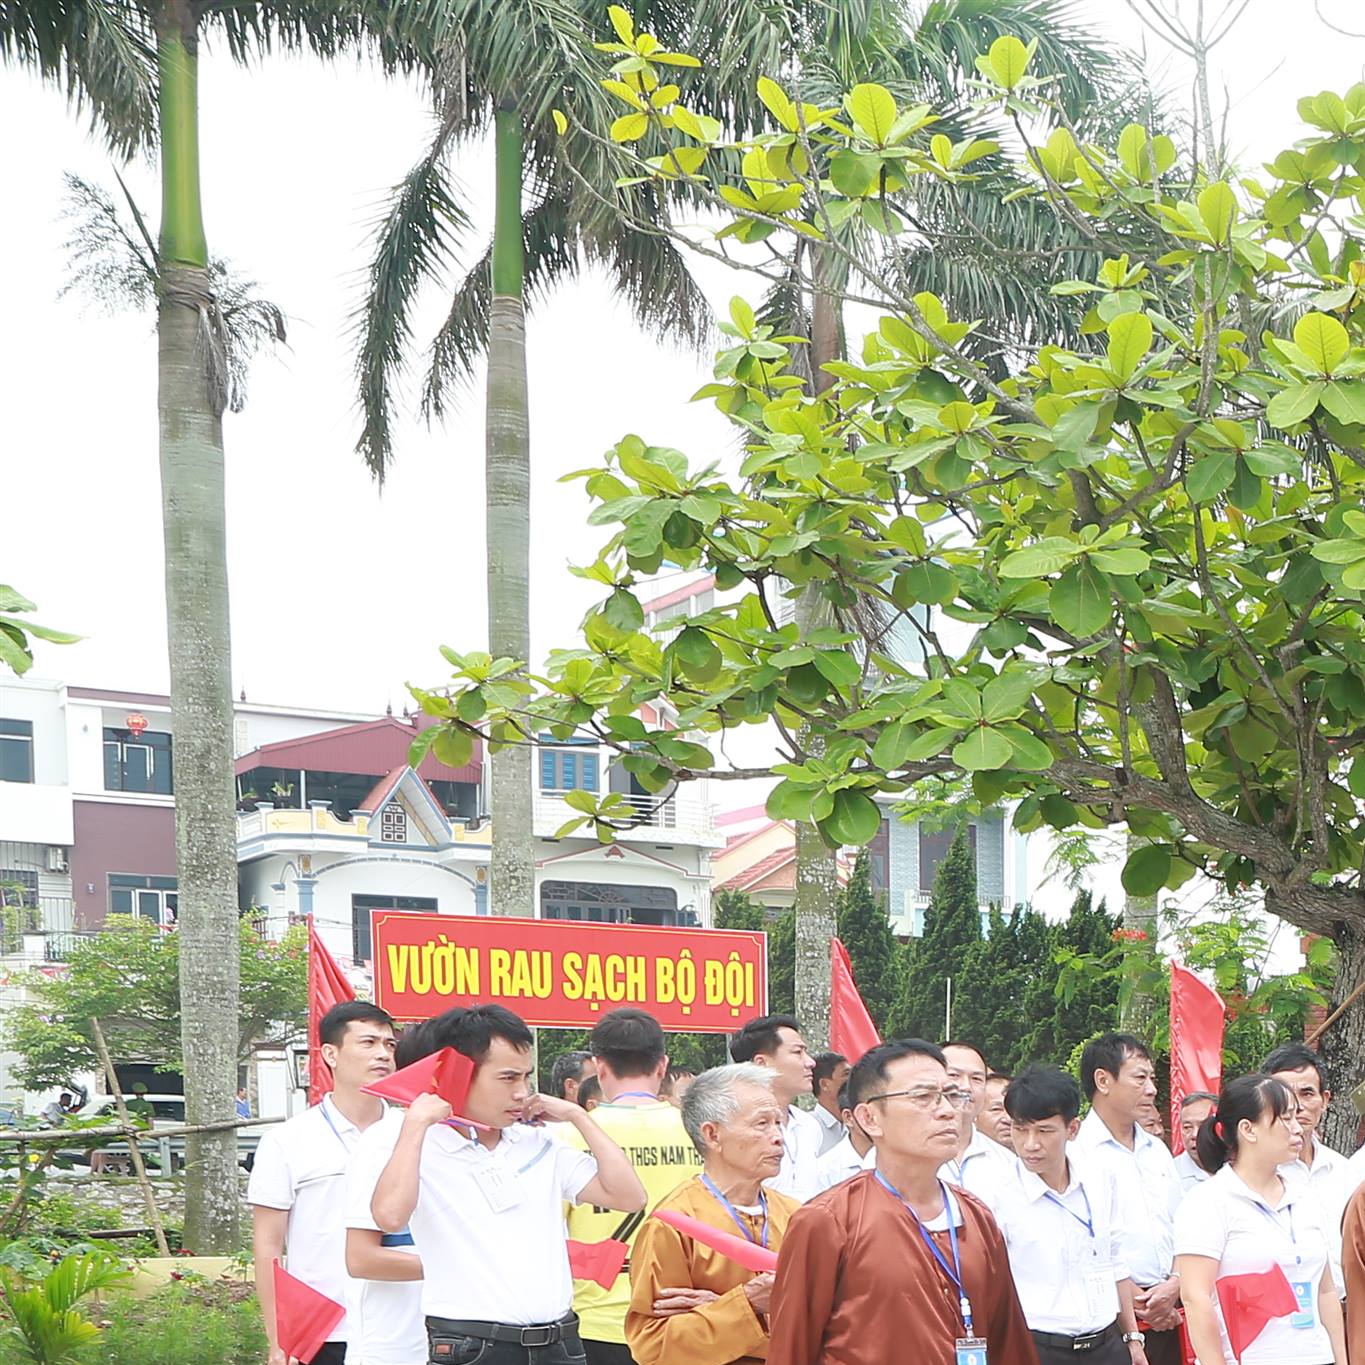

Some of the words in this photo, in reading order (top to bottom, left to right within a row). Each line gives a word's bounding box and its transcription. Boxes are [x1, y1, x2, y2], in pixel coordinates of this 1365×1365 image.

[387, 934, 480, 996] VƯỜN
[489, 948, 553, 999] RAU
[562, 954, 647, 1011] SẠCH
[656, 949, 697, 1015] BỘ
[704, 952, 755, 1017] ĐỘI
[661, 1146, 685, 1166] NAM
